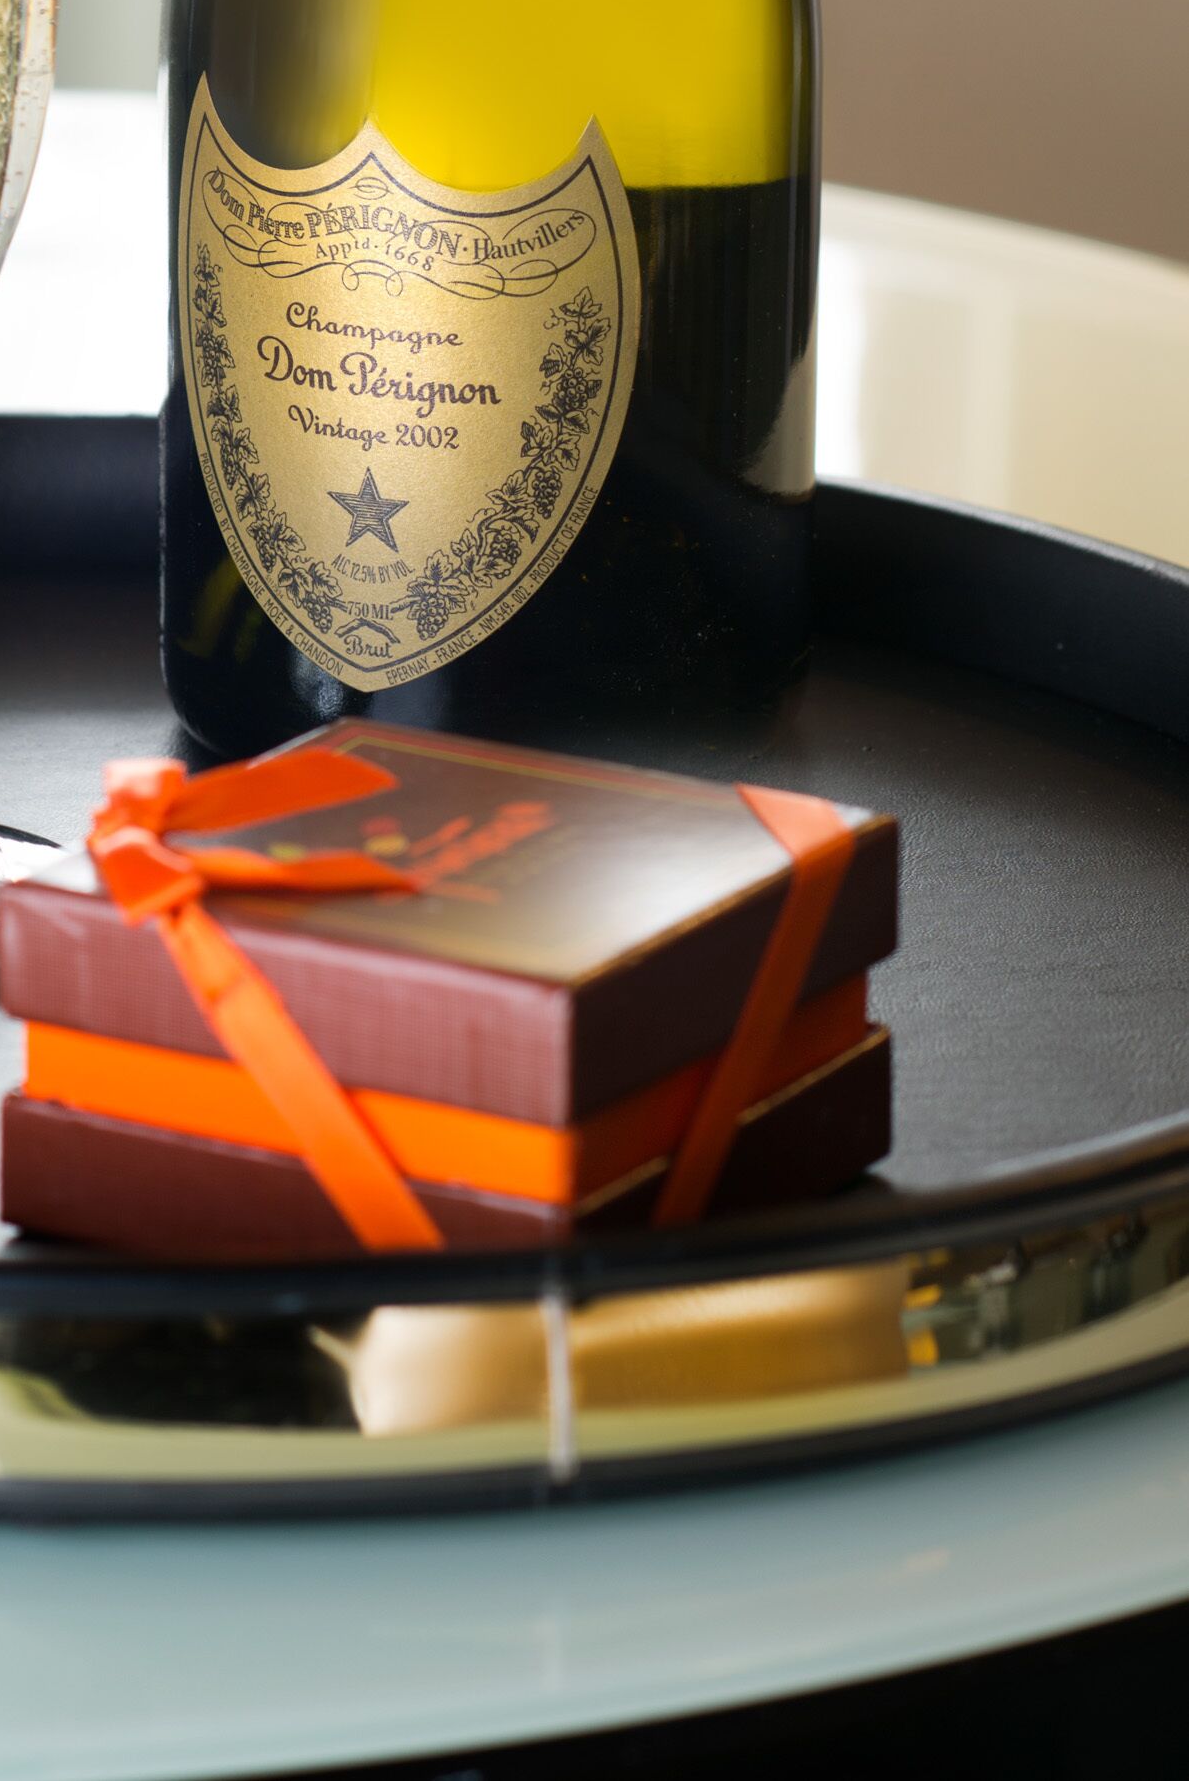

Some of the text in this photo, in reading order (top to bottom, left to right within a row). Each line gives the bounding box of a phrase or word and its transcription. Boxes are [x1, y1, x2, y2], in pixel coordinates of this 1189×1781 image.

[208, 167, 586, 260] Dom Pierre PÉRIGNON Hautvillers
[385, 244, 434, 271] 1668
[286, 301, 463, 354] Champagne
[257, 336, 502, 418] Dom Pérignon
[288, 405, 459, 452] Vintage 2002
[569, 486, 598, 526] FRANCE
[562, 523, 577, 540] OF
[200, 453, 223, 513] PRODUCED
[220, 518, 231, 532] BY
[227, 535, 265, 599] CHAMPAGNE
[294, 633, 344, 676] CHANDON
[378, 565, 392, 584] BY
[530, 538, 566, 584] PRODUCT
[344, 634, 393, 658] Brut
[435, 630, 477, 663] FRANCE
[385, 656, 430, 685] EPERNAY
